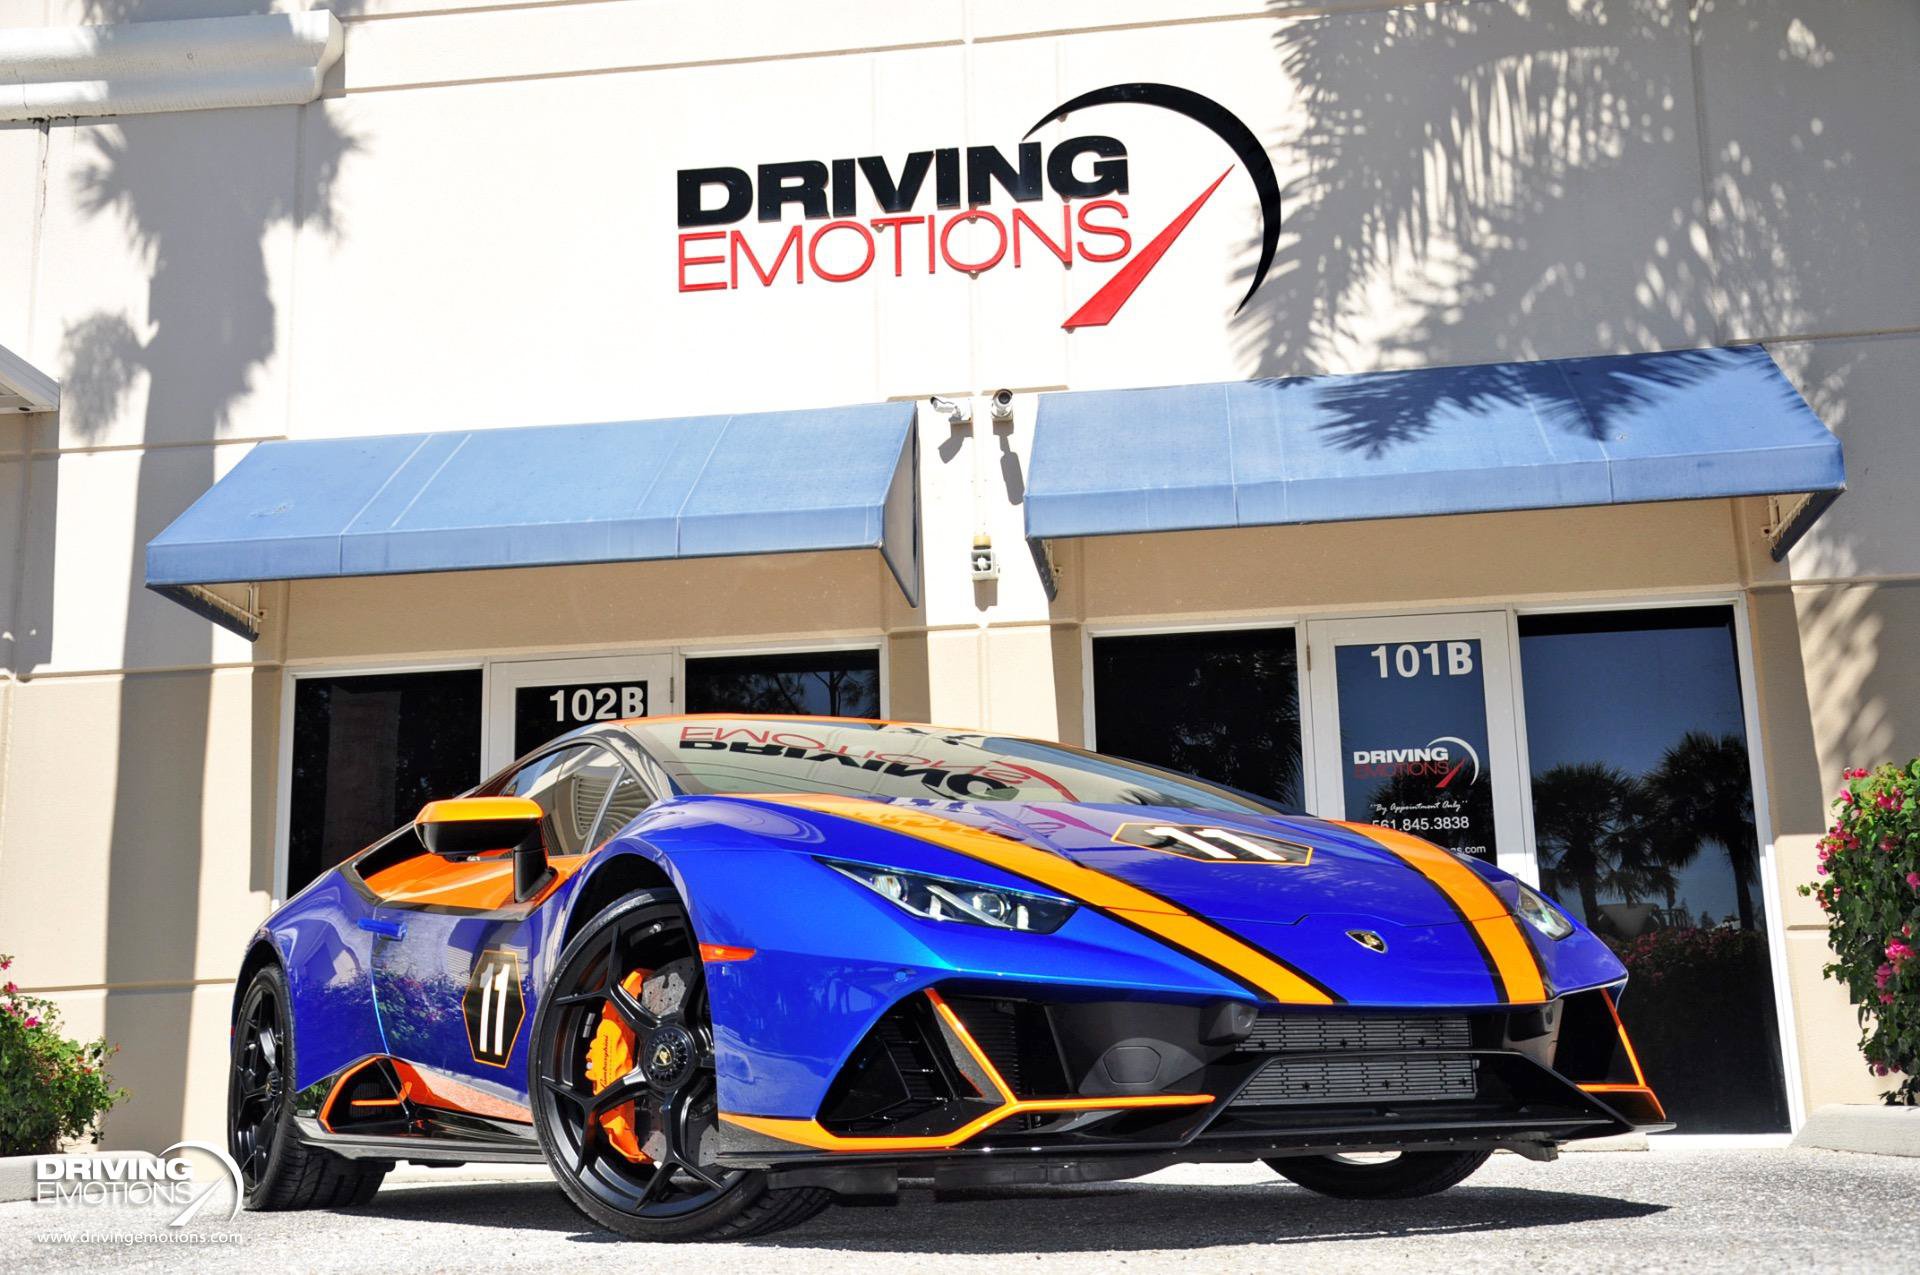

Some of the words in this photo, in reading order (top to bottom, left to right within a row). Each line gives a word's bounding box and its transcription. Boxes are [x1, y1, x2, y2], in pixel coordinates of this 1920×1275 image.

[677, 135, 1129, 228] DRIVING
[678, 199, 1132, 292] EMOTIONS
[1370, 641, 1473, 678] 101B
[549, 686, 644, 722] 102B
[1353, 747, 1449, 764] DRIVING
[1354, 761, 1450, 780] EMOTIONS
[1389, 801, 1441, 813] Appointment
[1145, 827, 1286, 861] 11
[479, 962, 511, 1057] 11
